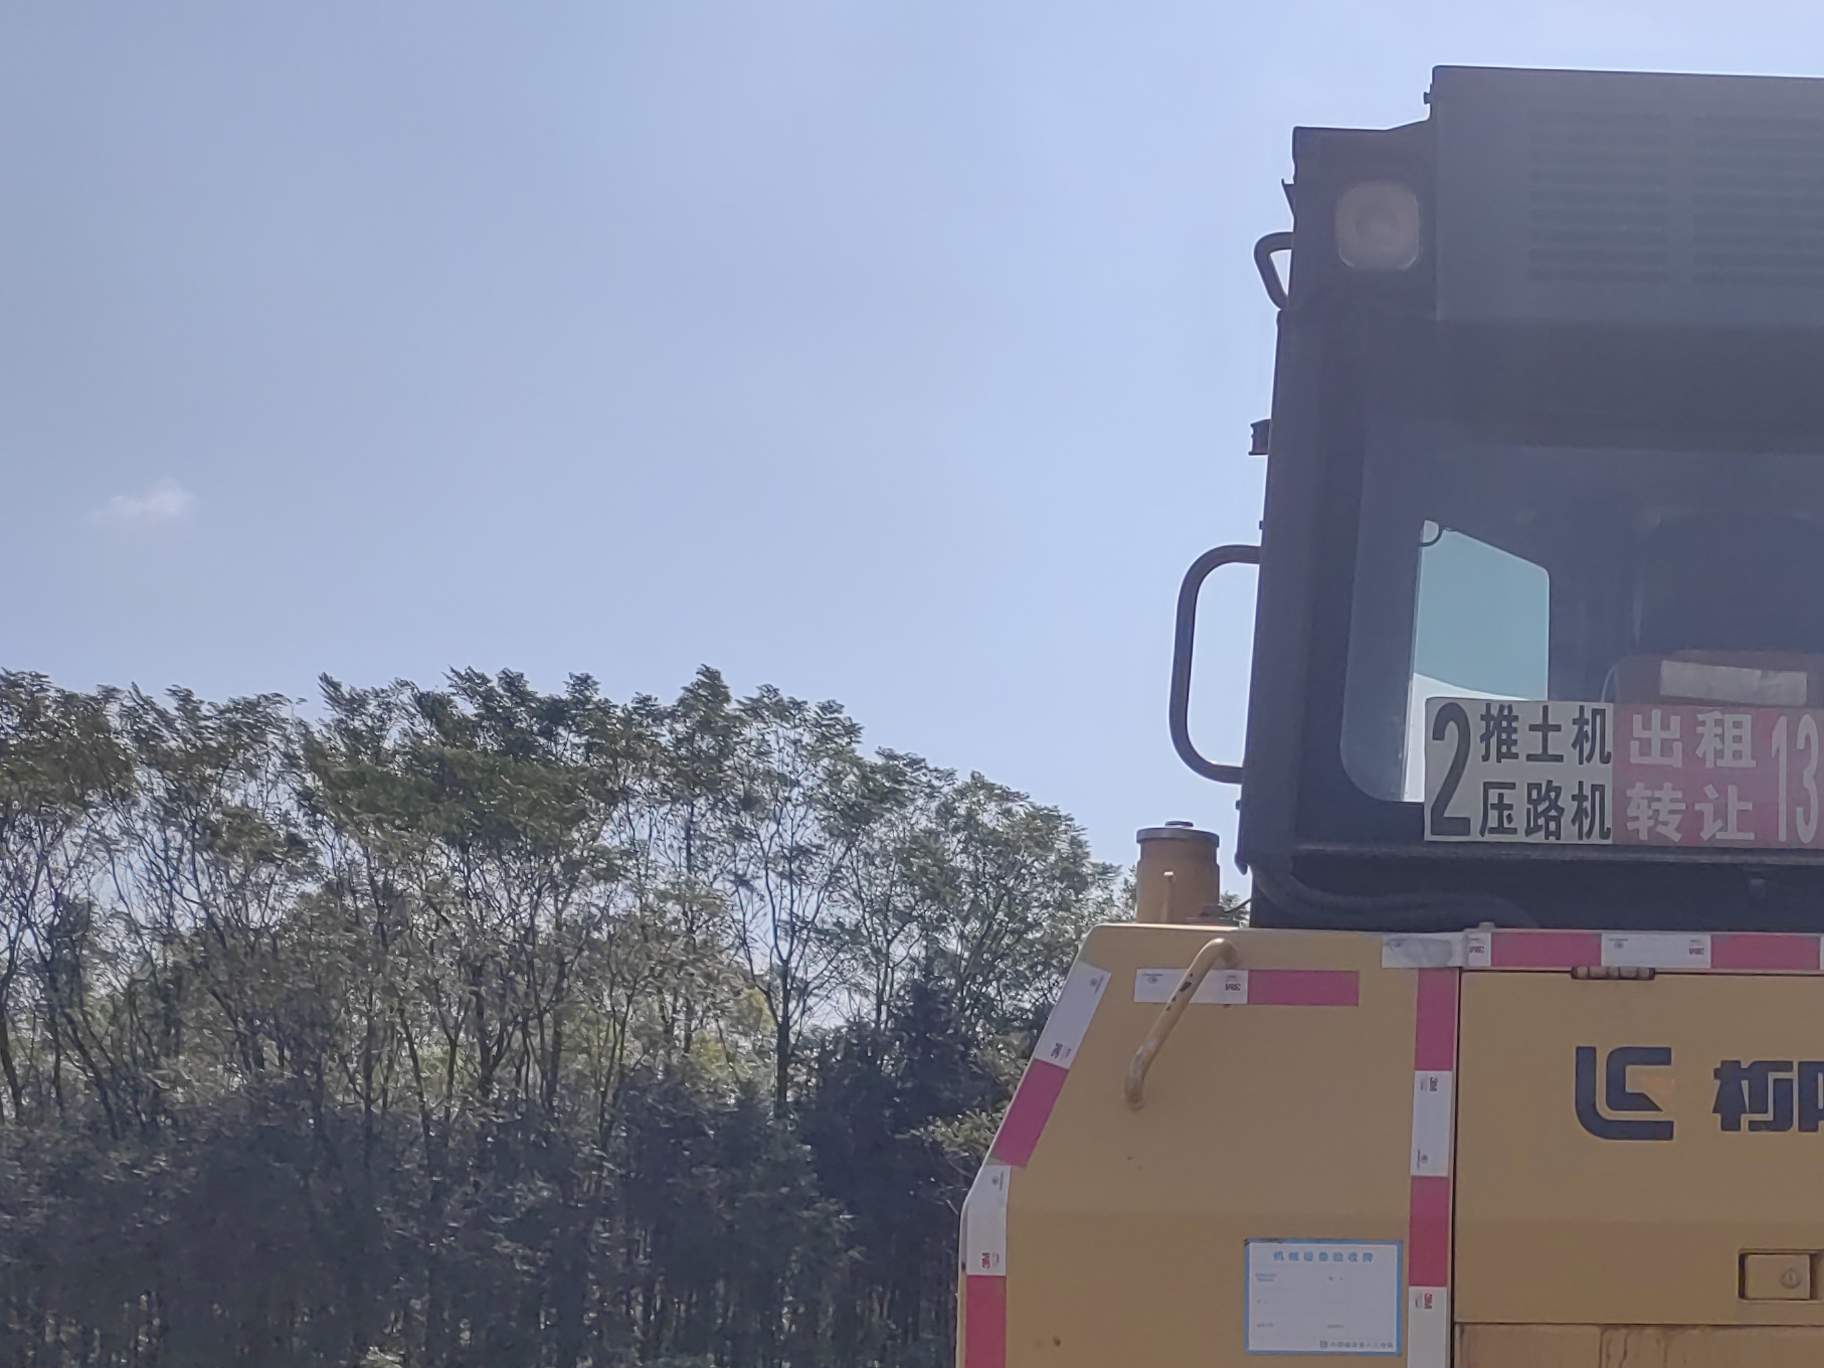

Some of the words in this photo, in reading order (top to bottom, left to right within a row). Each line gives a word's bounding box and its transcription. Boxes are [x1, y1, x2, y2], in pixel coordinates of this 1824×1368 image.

[1479, 702, 1612, 765] 推土机
[1629, 708, 1757, 768] 出租
[1430, 702, 1471, 836] 2
[1479, 779, 1612, 841] 压路机
[1626, 782, 1756, 843] 转让
